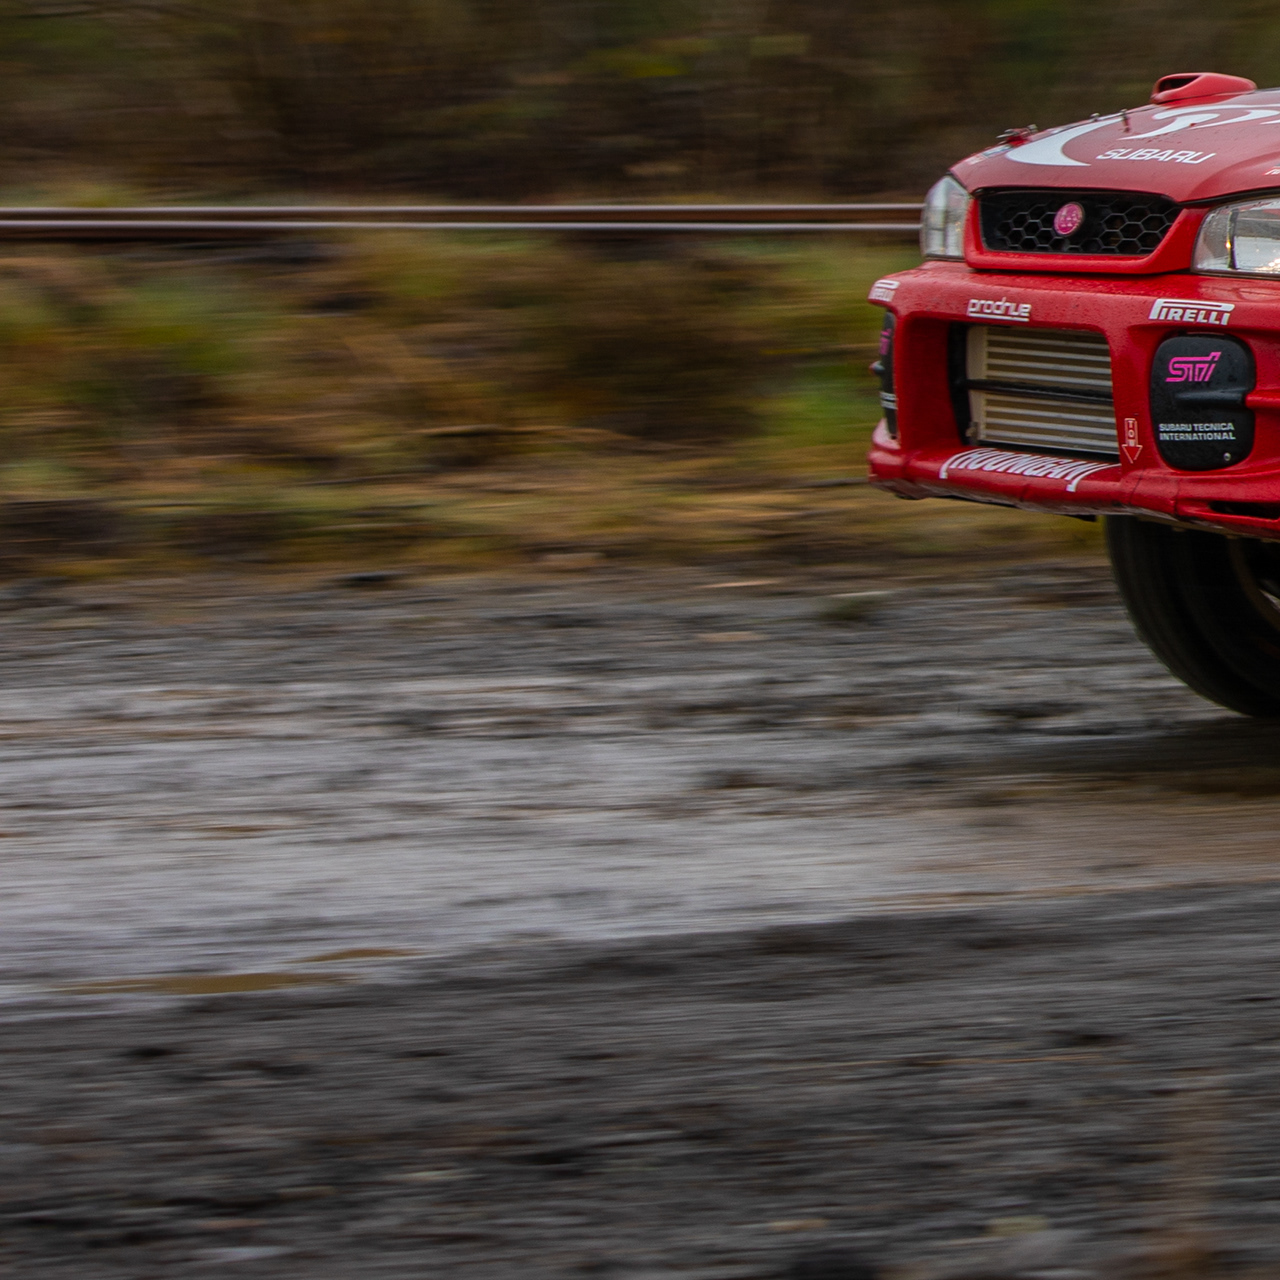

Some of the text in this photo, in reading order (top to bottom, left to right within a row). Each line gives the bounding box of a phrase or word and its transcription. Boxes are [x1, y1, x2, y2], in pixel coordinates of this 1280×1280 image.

[1097, 148, 1216, 164] SUBARU
[1149, 298, 1236, 325] PIRELLI
[1158, 423, 1236, 432] SUBARU TECNICA
[1158, 432, 1237, 441] INTERNATIONAL
